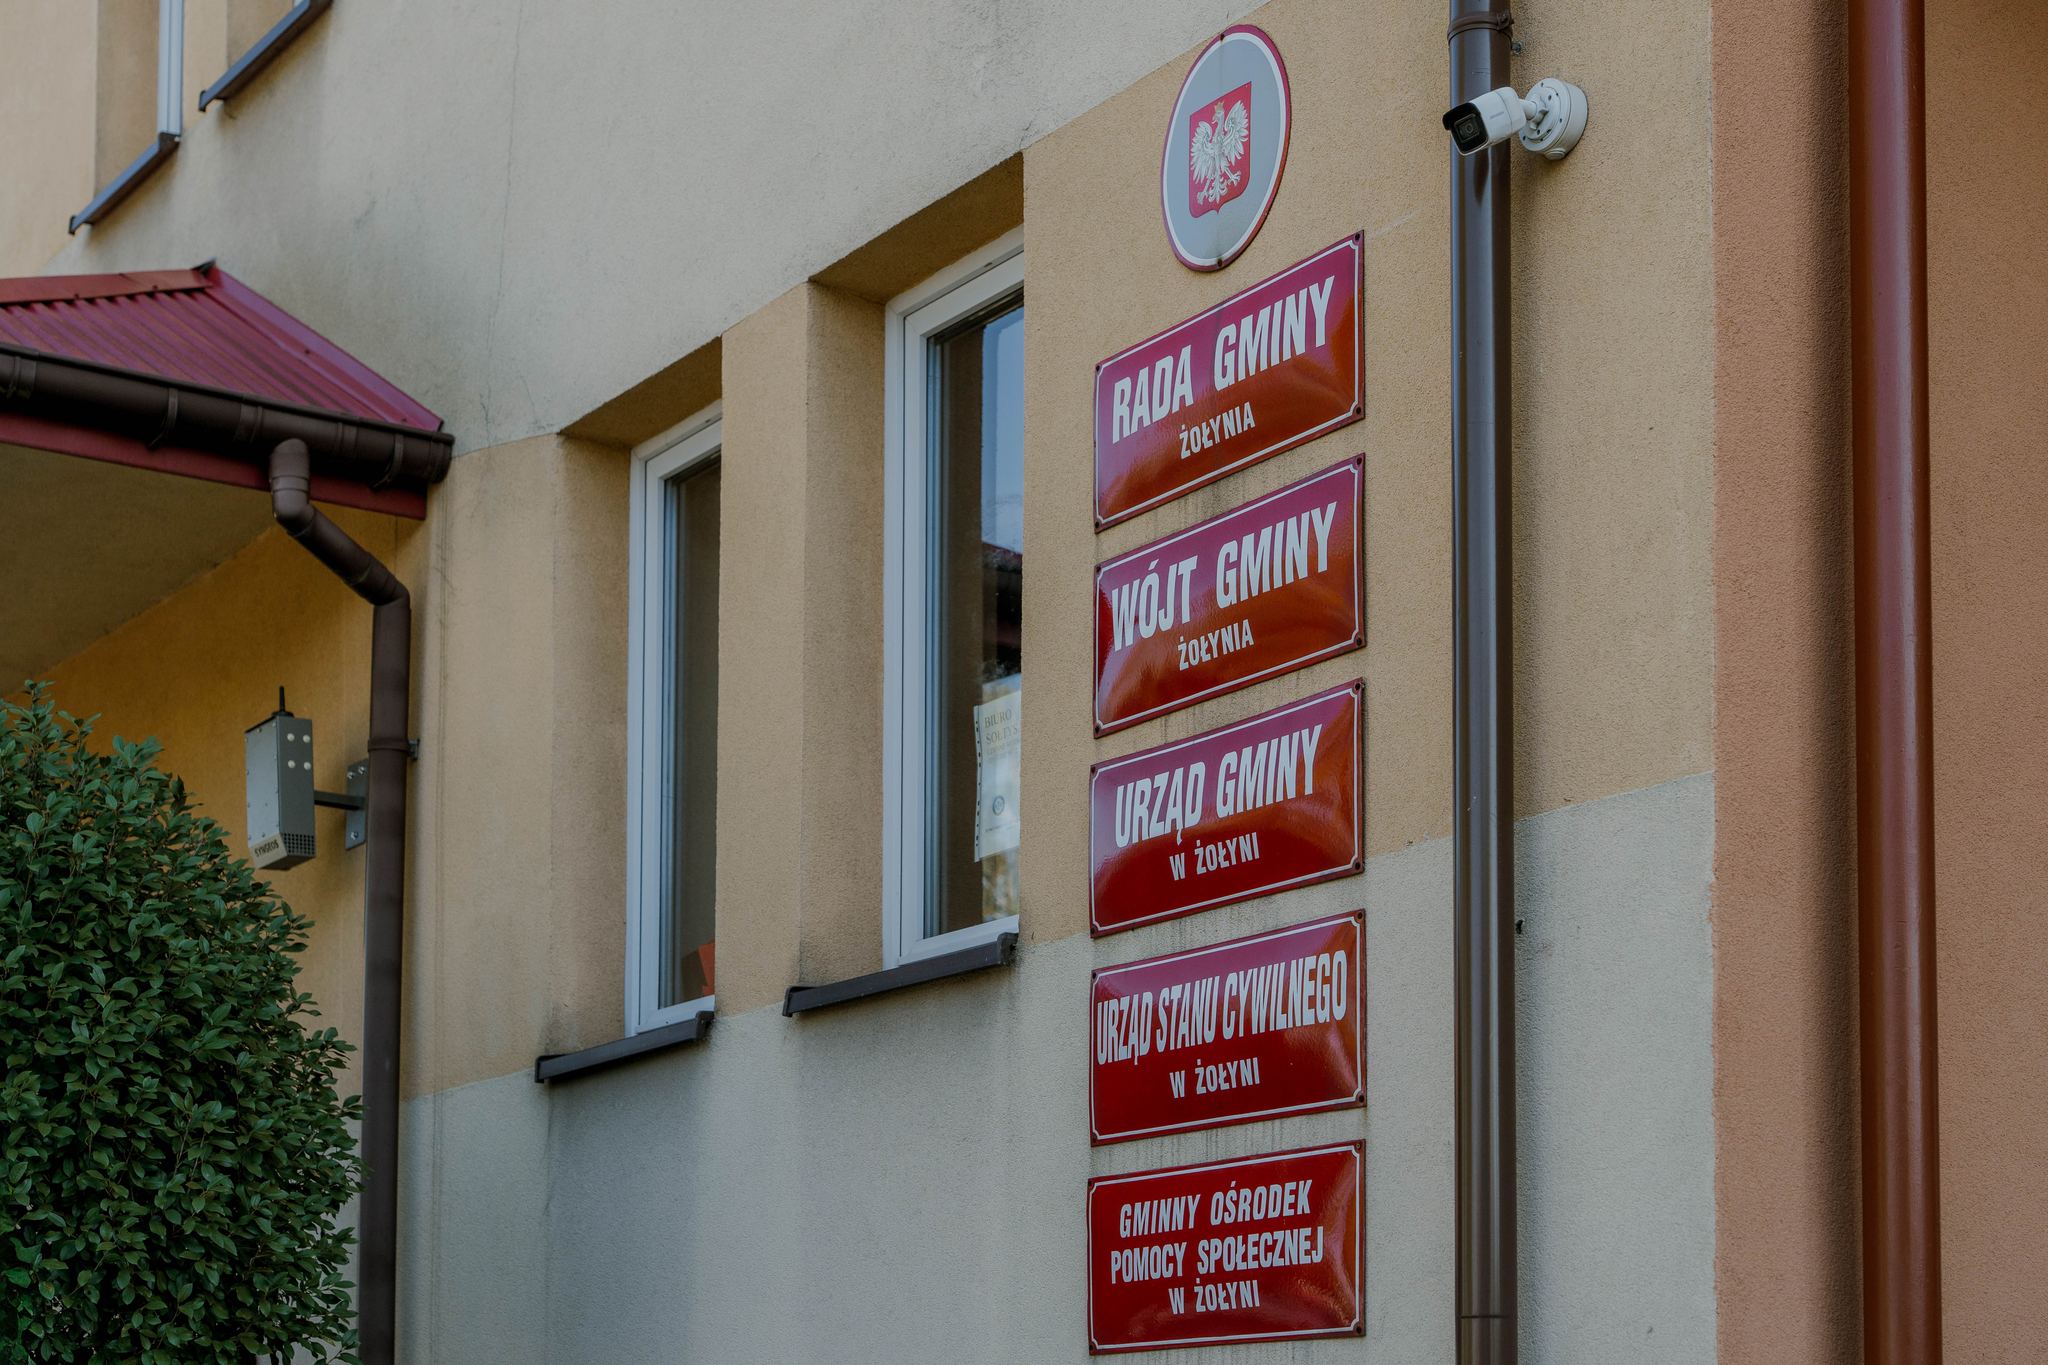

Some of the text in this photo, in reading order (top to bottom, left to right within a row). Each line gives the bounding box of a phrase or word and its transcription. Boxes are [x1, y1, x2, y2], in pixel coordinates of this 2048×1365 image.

[1112, 275, 1335, 444] RADA GMINY
[1179, 401, 1256, 460] ŻOŁYNIA
[1111, 501, 1337, 652] WÓJT GMINY
[1177, 618, 1255, 671] ŻOŁYNIA
[984, 707, 1013, 729] BIURO
[1115, 723, 1323, 848] URZĄD GMINY
[1169, 831, 1260, 881] W ŻOŁYNI
[1097, 950, 1348, 1066] URZĄD STANU CYWILNEGO
[1169, 1057, 1260, 1099] W ŻOŁYNI
[1119, 1179, 1313, 1239] GMINNY OŚRODEK
[1111, 1225, 1324, 1285] POMOCY SPOŁECZNEJ
[1168, 1277, 1260, 1315] W ŻOŁYNI
